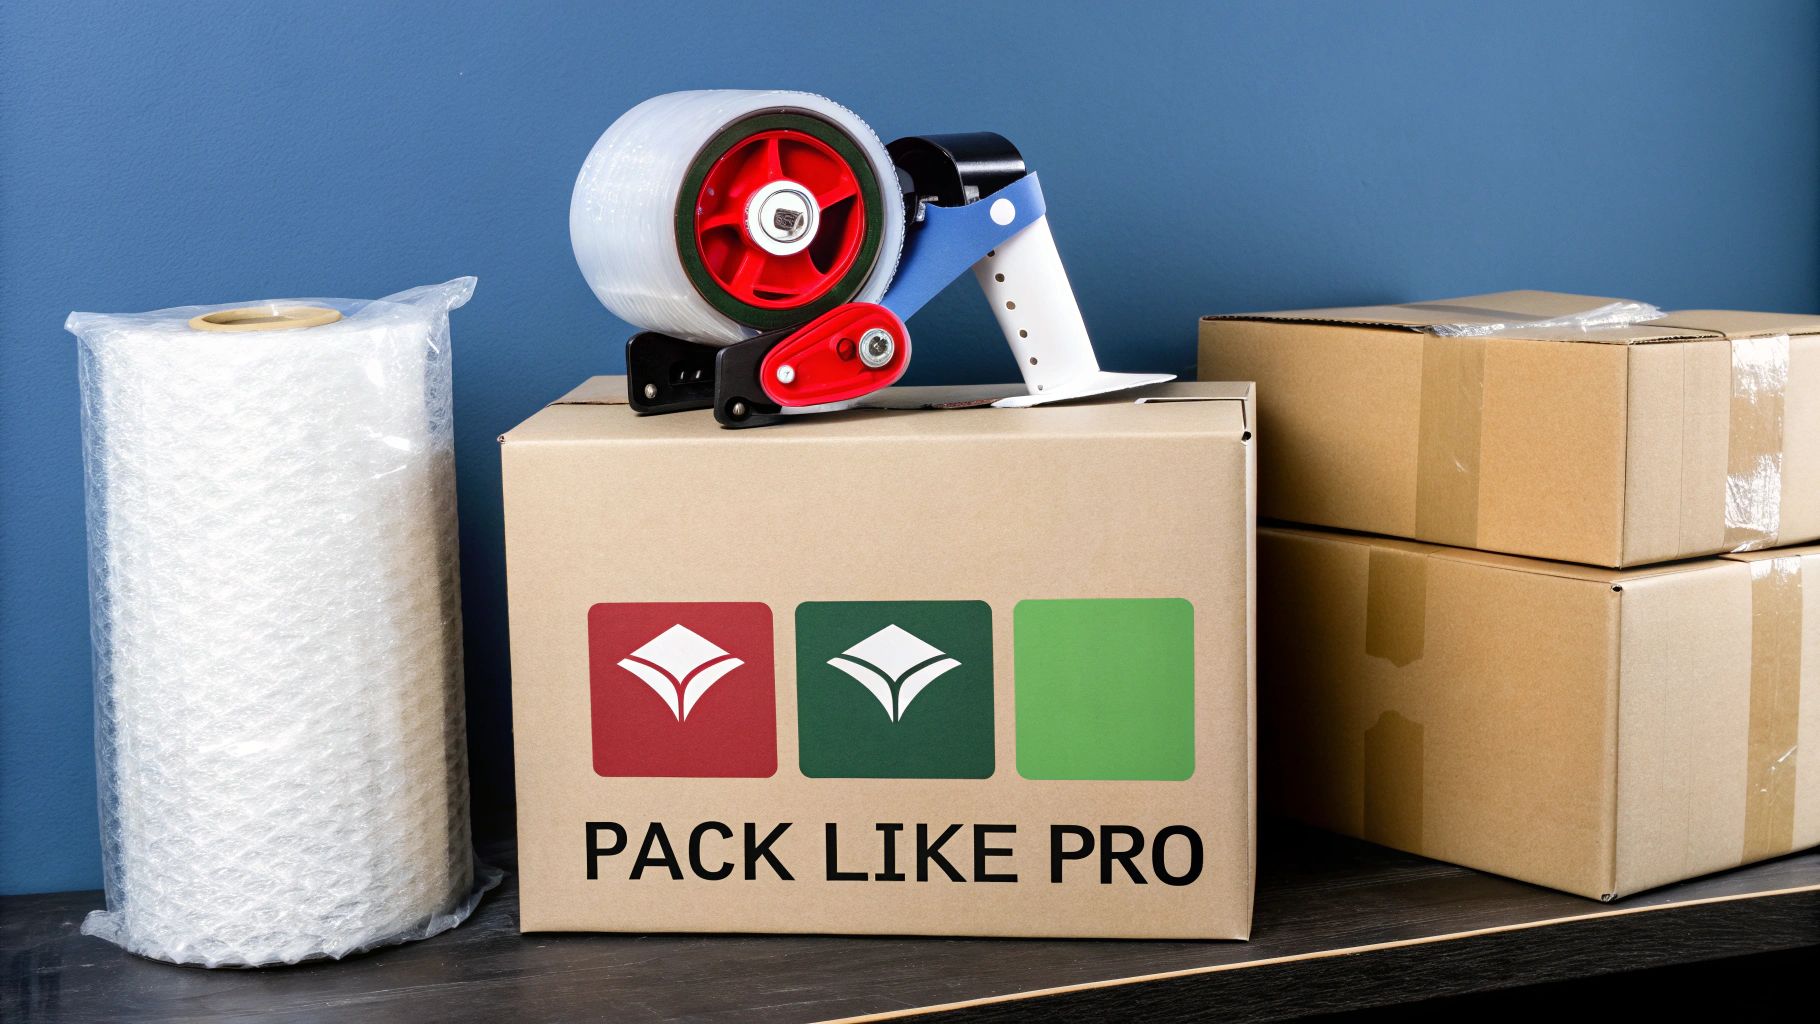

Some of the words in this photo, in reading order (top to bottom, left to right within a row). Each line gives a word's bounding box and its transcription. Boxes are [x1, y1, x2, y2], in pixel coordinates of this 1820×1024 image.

[585, 820, 795, 880] PACK
[825, 822, 1018, 882] LIKE
[1050, 824, 1204, 886] PRO
